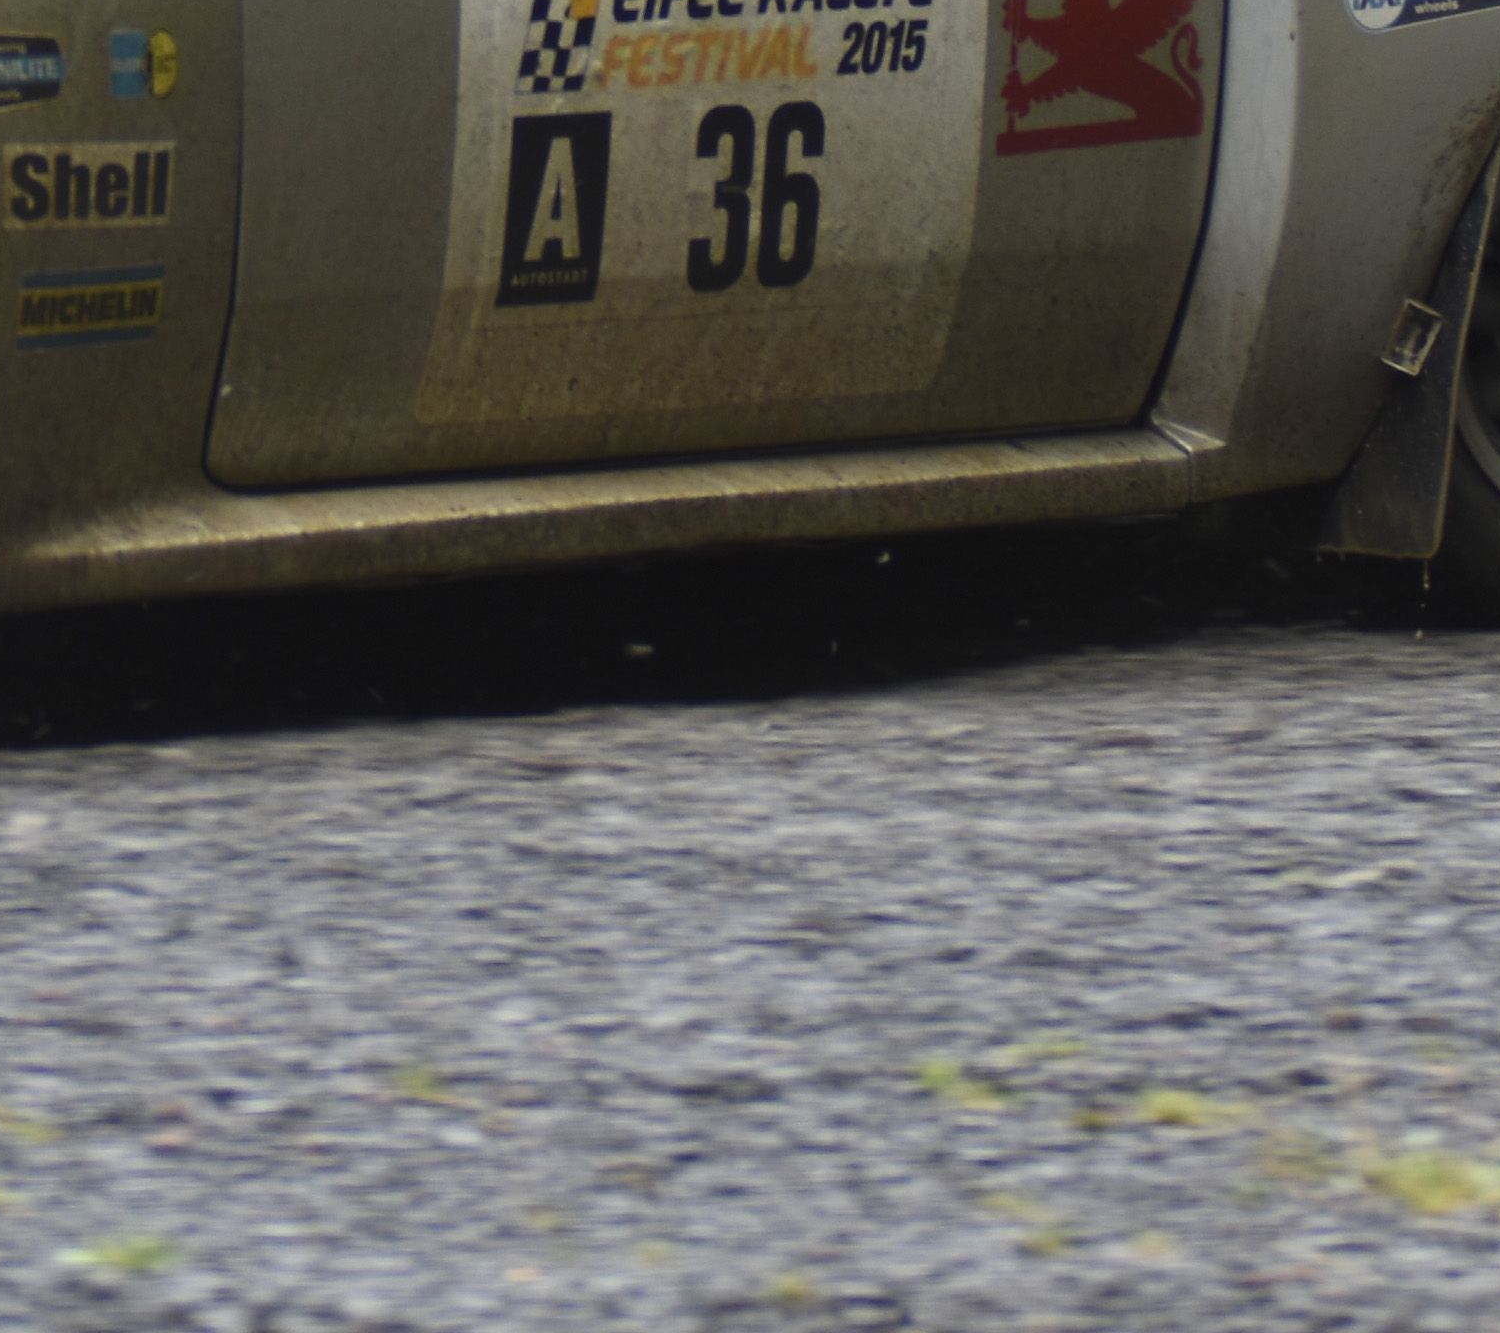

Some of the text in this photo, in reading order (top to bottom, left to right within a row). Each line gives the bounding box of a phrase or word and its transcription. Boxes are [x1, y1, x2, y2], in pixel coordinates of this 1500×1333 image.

[600, 18, 929, 89] FESTIVAL 2015
[9, 149, 171, 223] Shell
[521, 134, 583, 264] A
[686, 99, 826, 293] 36
[20, 286, 159, 327] MICHELIN
